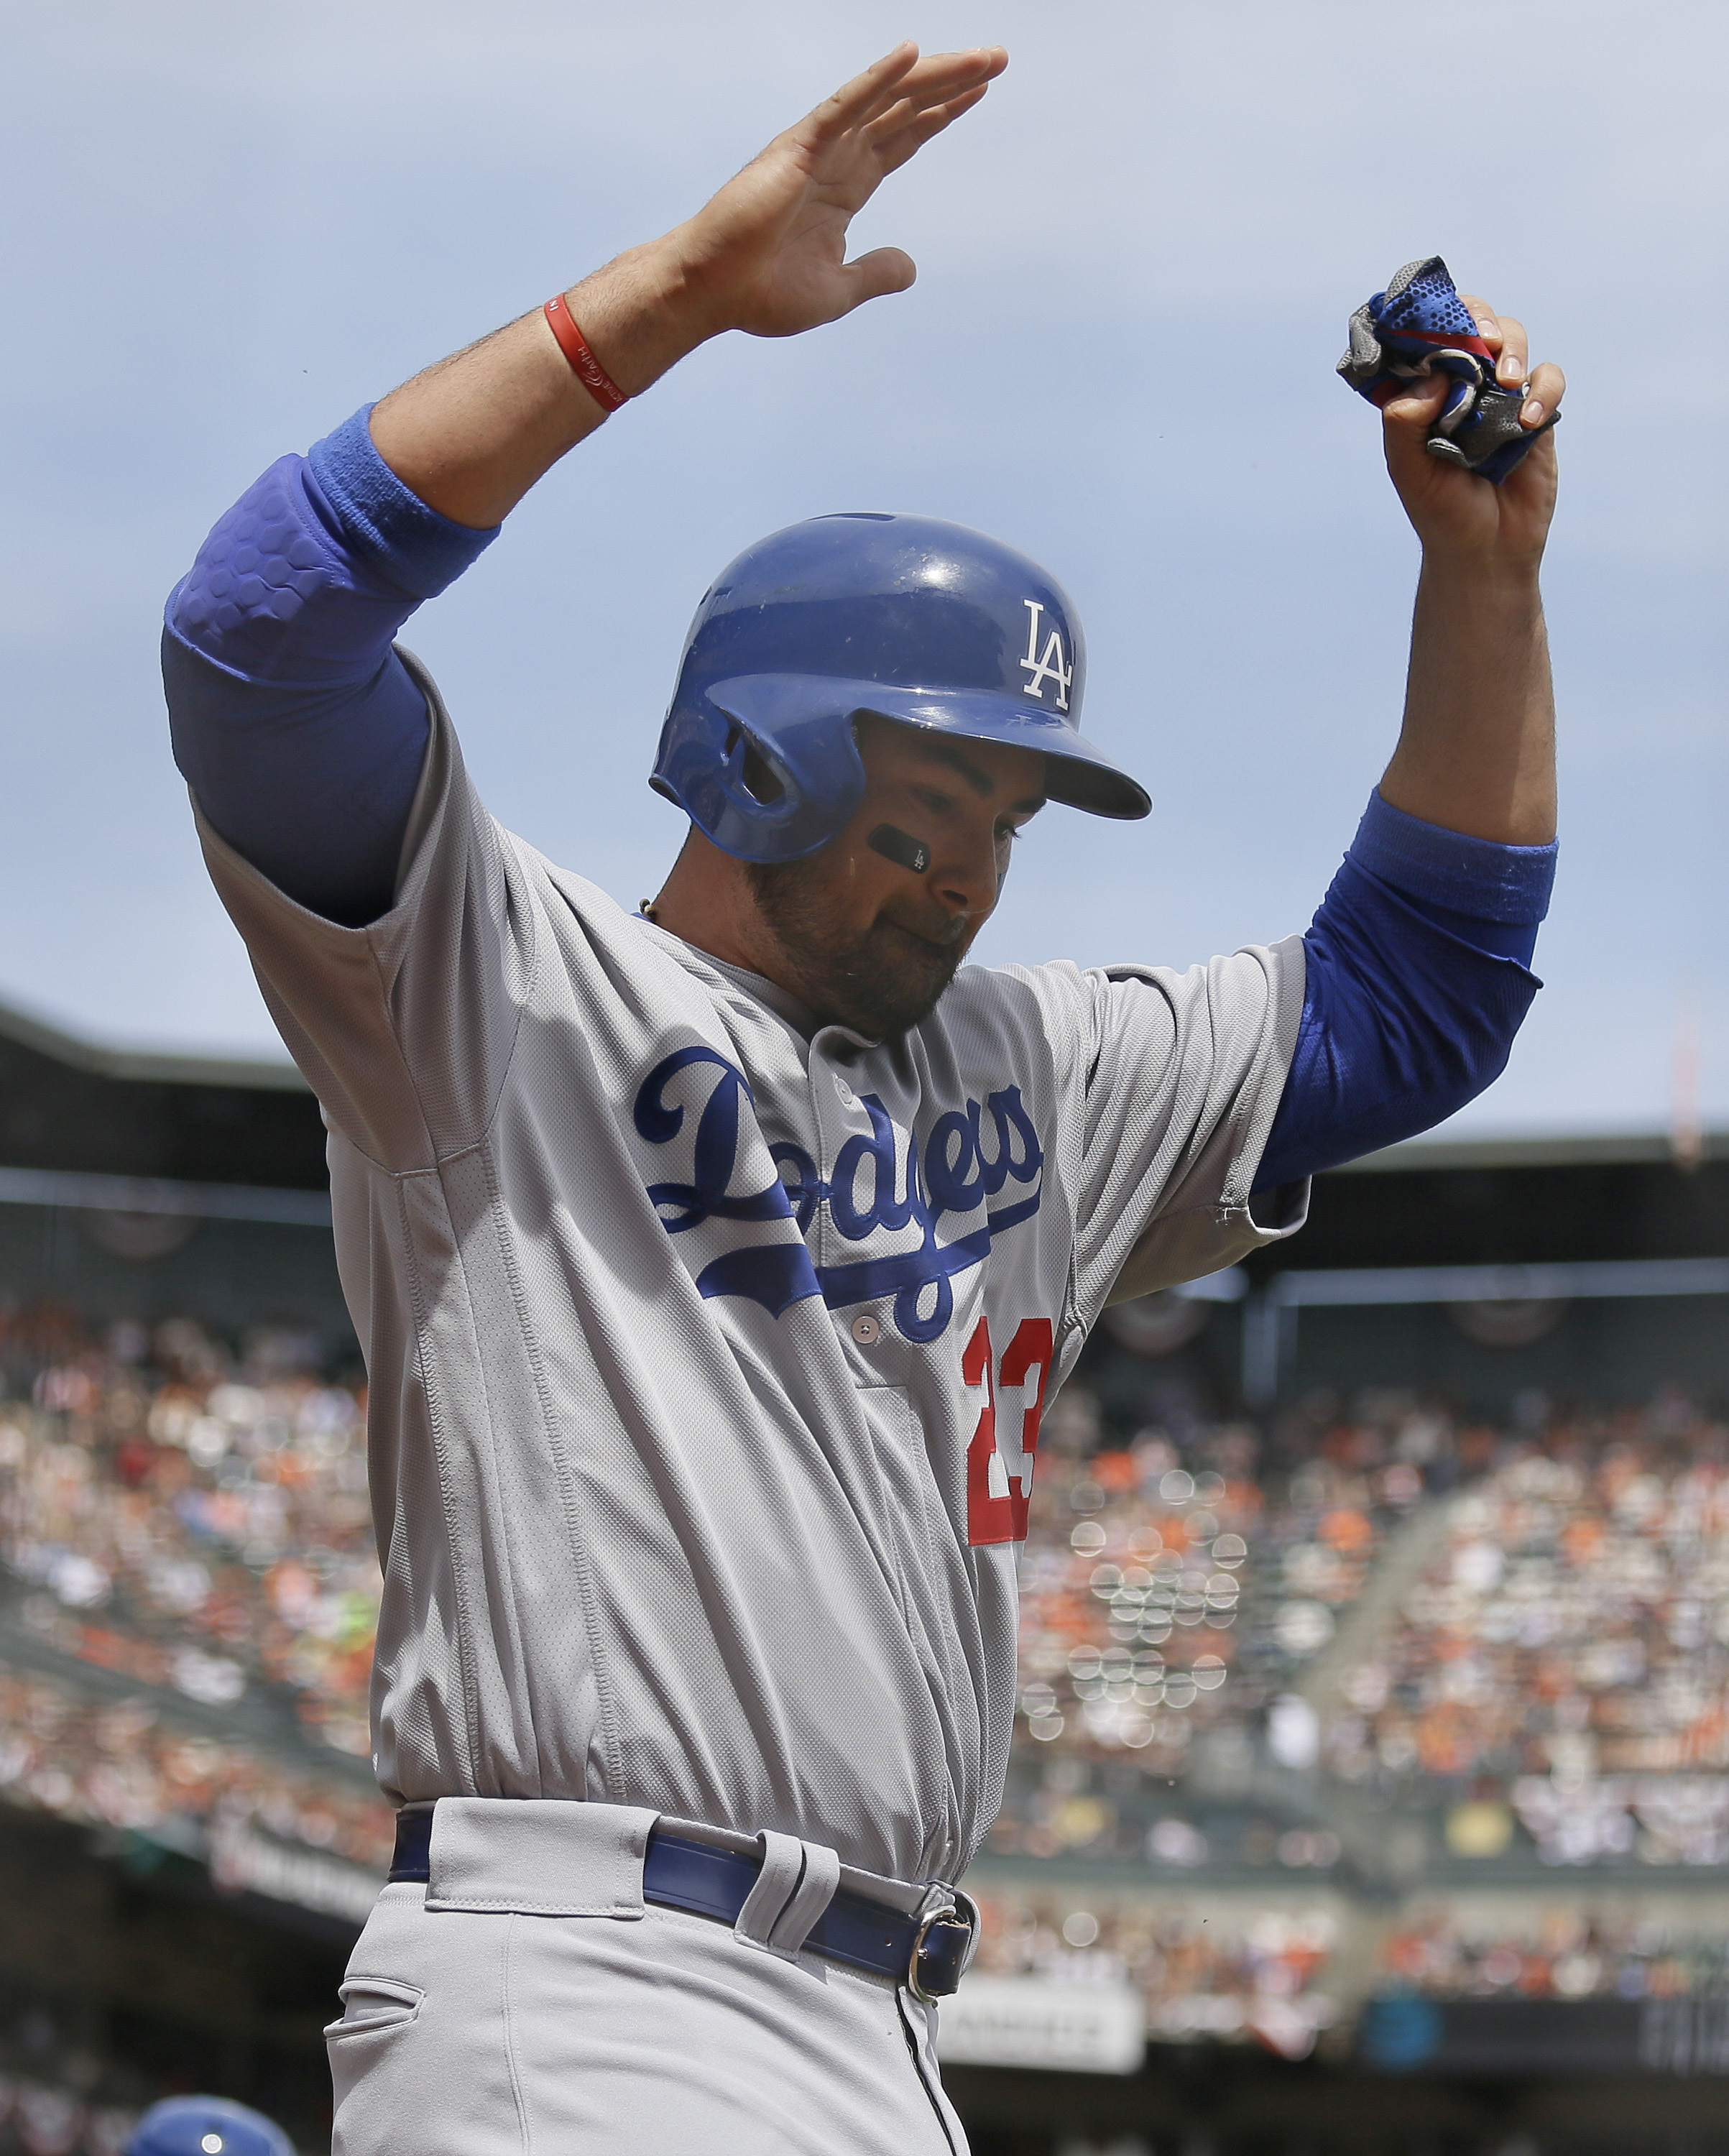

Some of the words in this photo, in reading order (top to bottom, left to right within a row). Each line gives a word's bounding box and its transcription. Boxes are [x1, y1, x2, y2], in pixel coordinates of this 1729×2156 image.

[1020, 599, 1073, 711] LA
[914, 849, 925, 870] LA
[962, 1316, 1053, 1545] 23
